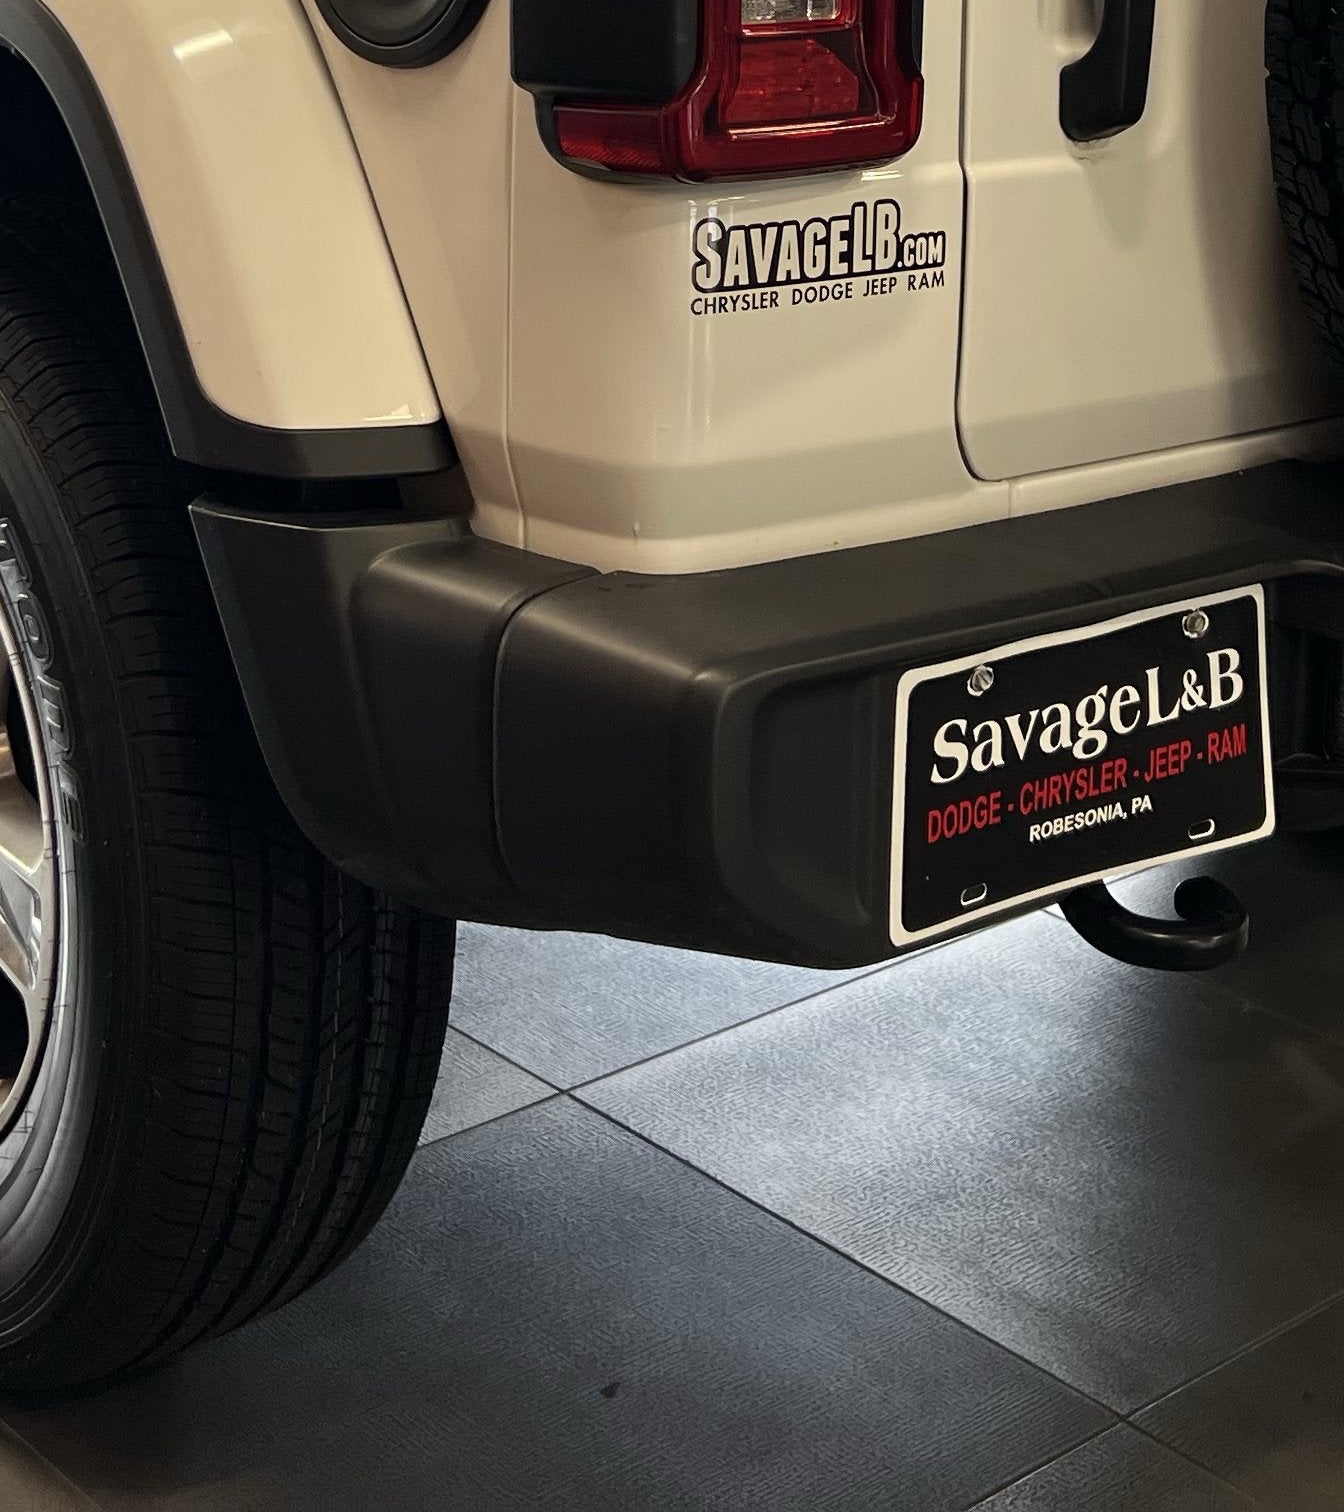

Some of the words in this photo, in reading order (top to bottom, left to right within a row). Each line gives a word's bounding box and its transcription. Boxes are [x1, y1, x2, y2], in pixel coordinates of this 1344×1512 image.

[691, 291, 779, 316] CHRYSLER
[792, 282, 853, 306] DODGE
[862, 277, 897, 298] JEEP
[907, 270, 945, 292] RAM
[926, 787, 1002, 845] DODGE
[1019, 757, 1127, 816] CHRYSLER
[1143, 739, 1192, 785] JEEP
[1208, 724, 1246, 765] RAM
[1029, 801, 1127, 843] ROBESONIA,
[1131, 794, 1155, 817] PA
